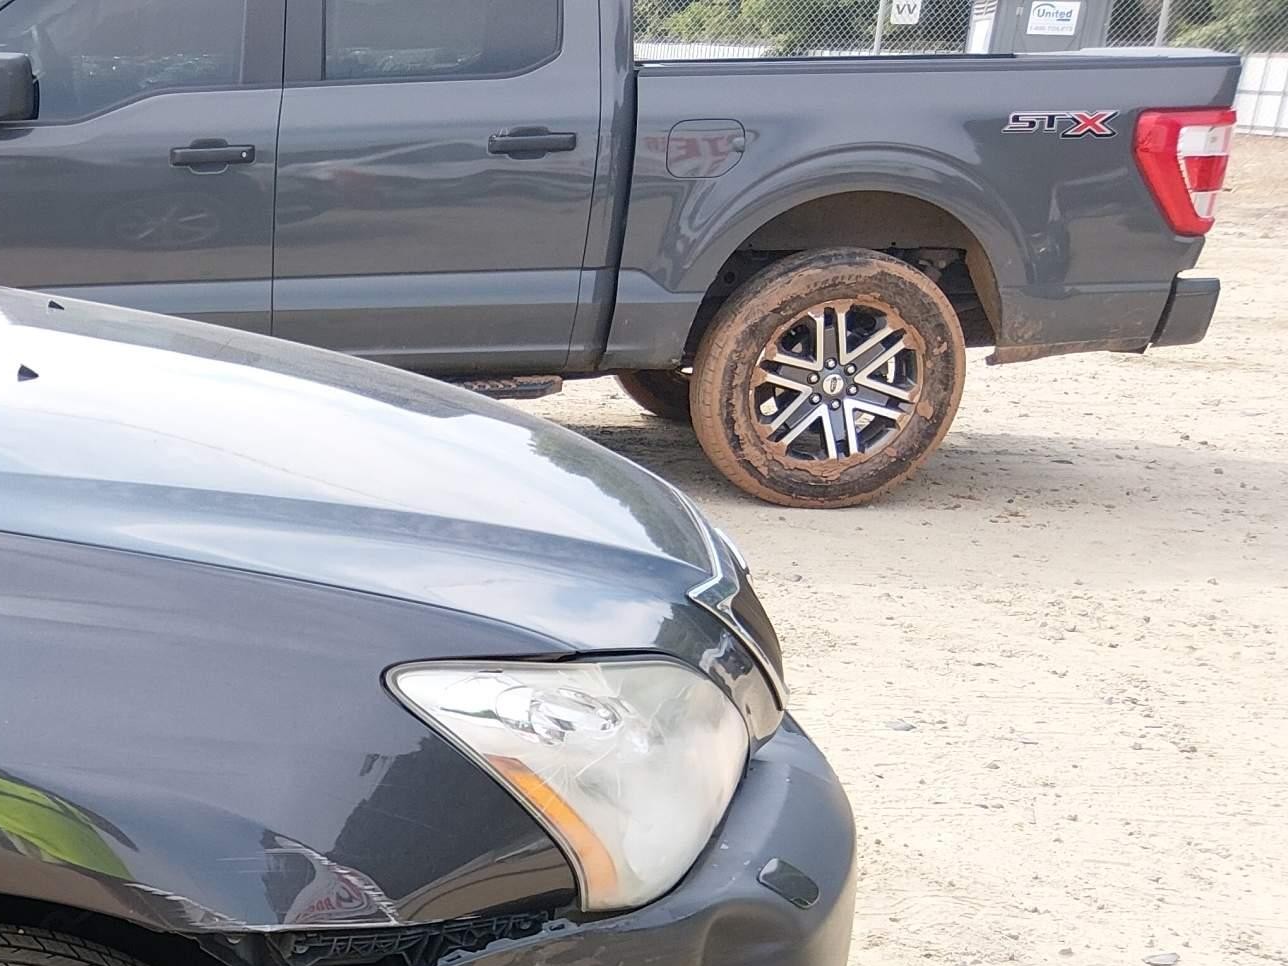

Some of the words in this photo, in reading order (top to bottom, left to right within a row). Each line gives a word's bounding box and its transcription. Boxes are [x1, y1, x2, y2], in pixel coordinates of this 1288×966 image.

[896, 3, 918, 15] VV
[1037, 9, 1073, 19] United
[1001, 110, 1120, 139] STX
